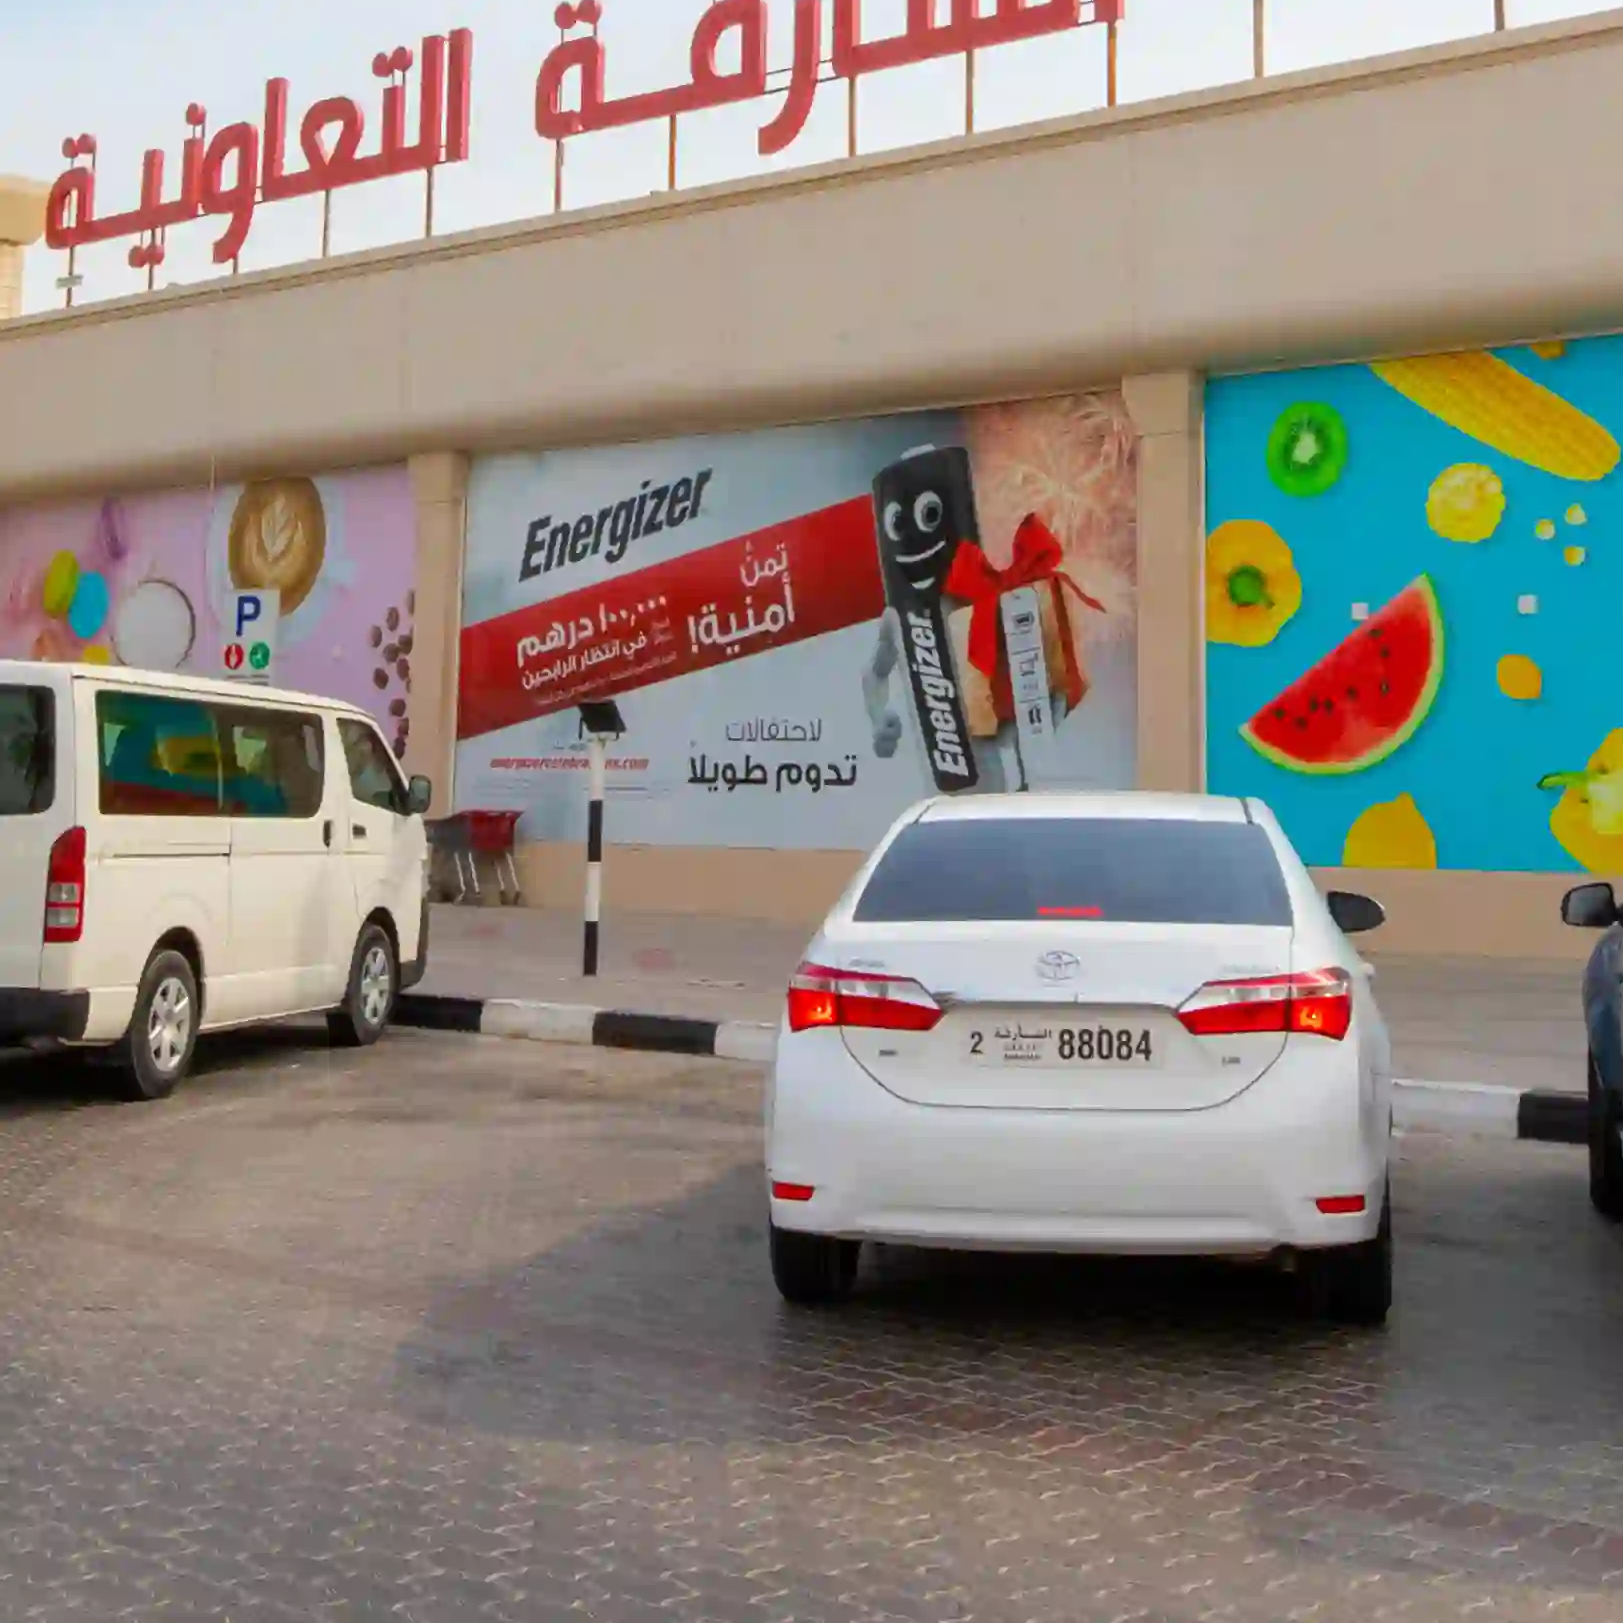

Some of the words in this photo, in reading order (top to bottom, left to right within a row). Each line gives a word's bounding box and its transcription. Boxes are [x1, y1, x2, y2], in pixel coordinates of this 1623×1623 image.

[43, 27, 471, 267] التعاونية
[518, 465, 714, 583] Energizer
[236, 595, 261, 637] P
[517, 616, 594, 668] درهم
[623, 631, 647, 660] في
[906, 610, 969, 777] Energizer
[776, 754, 857, 792] تدوم
[970, 1031, 984, 1054] 2
[1058, 1027, 1152, 1060] 88084
